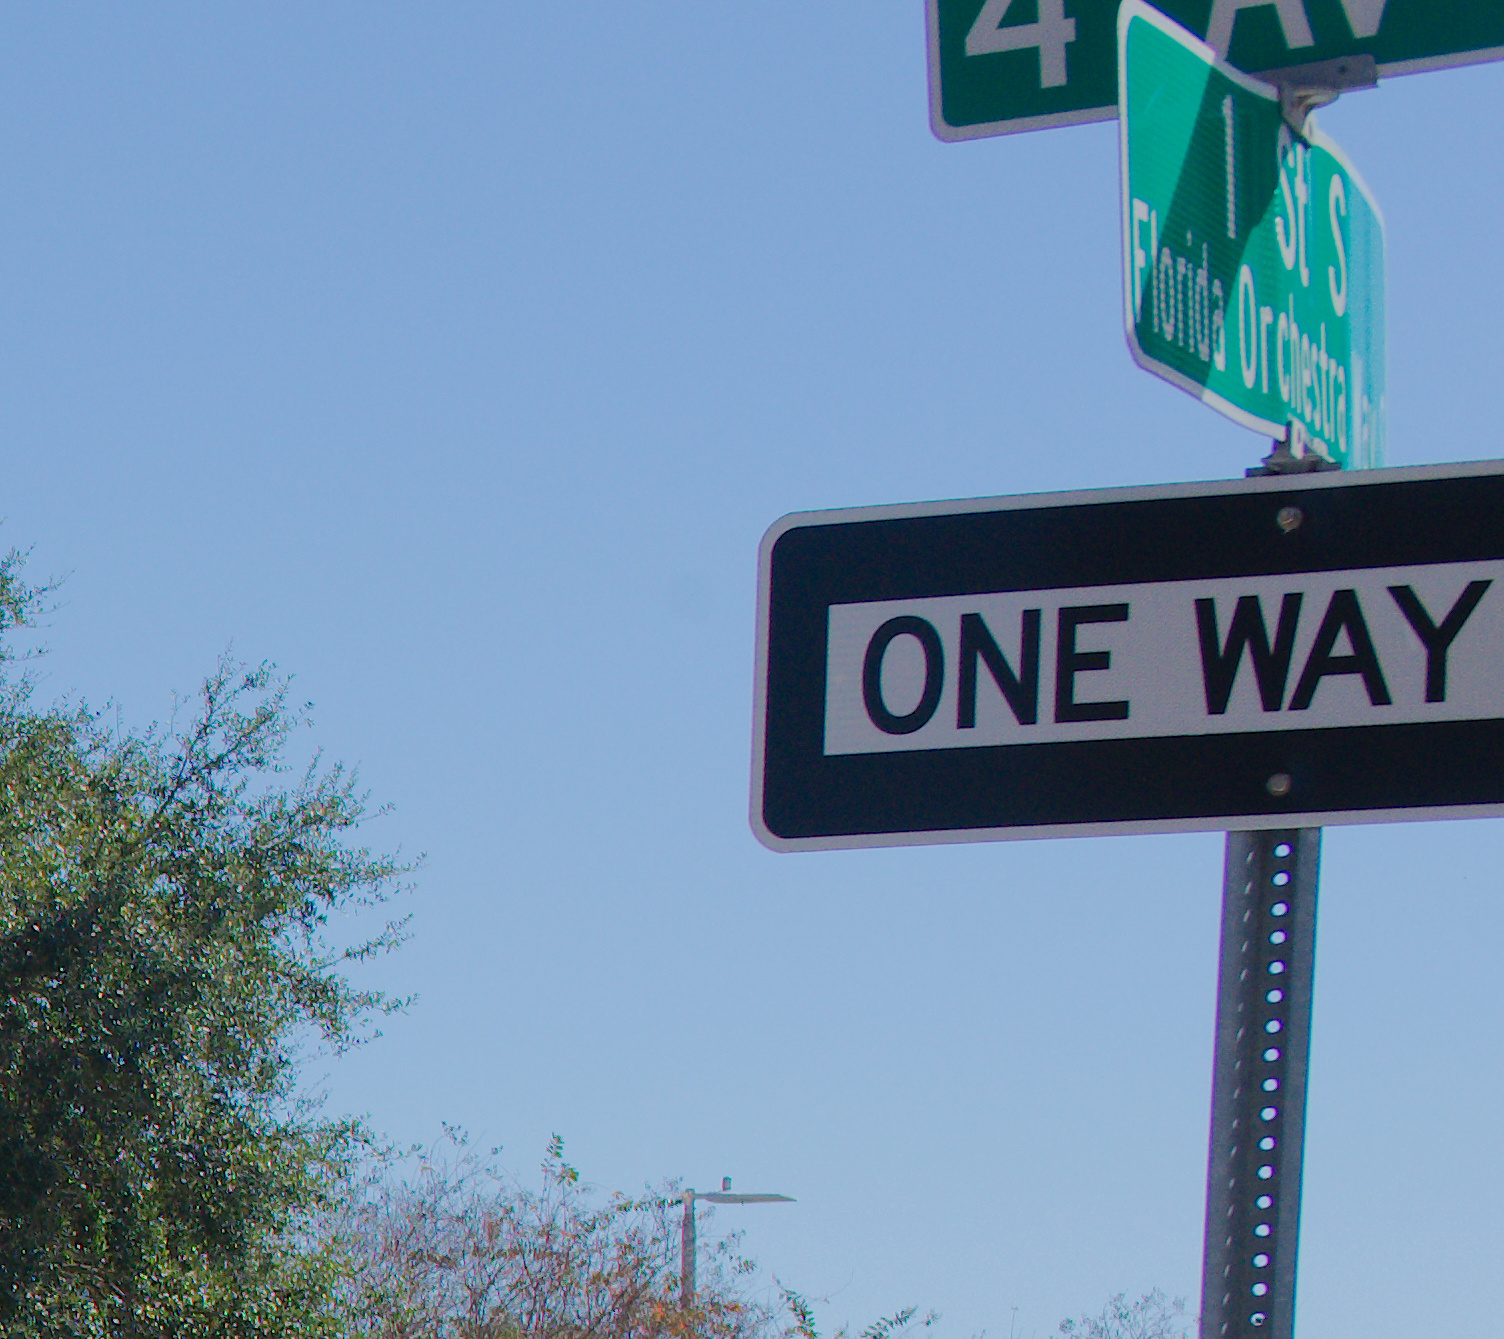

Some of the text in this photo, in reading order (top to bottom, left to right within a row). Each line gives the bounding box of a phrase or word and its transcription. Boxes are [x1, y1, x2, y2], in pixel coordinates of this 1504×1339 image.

[1275, 143, 1310, 287] St
[1328, 173, 1348, 317] S
[1132, 197, 1226, 372] Florida
[1239, 263, 1347, 453] Orchestra
[862, 578, 1494, 736] ONE WAY
